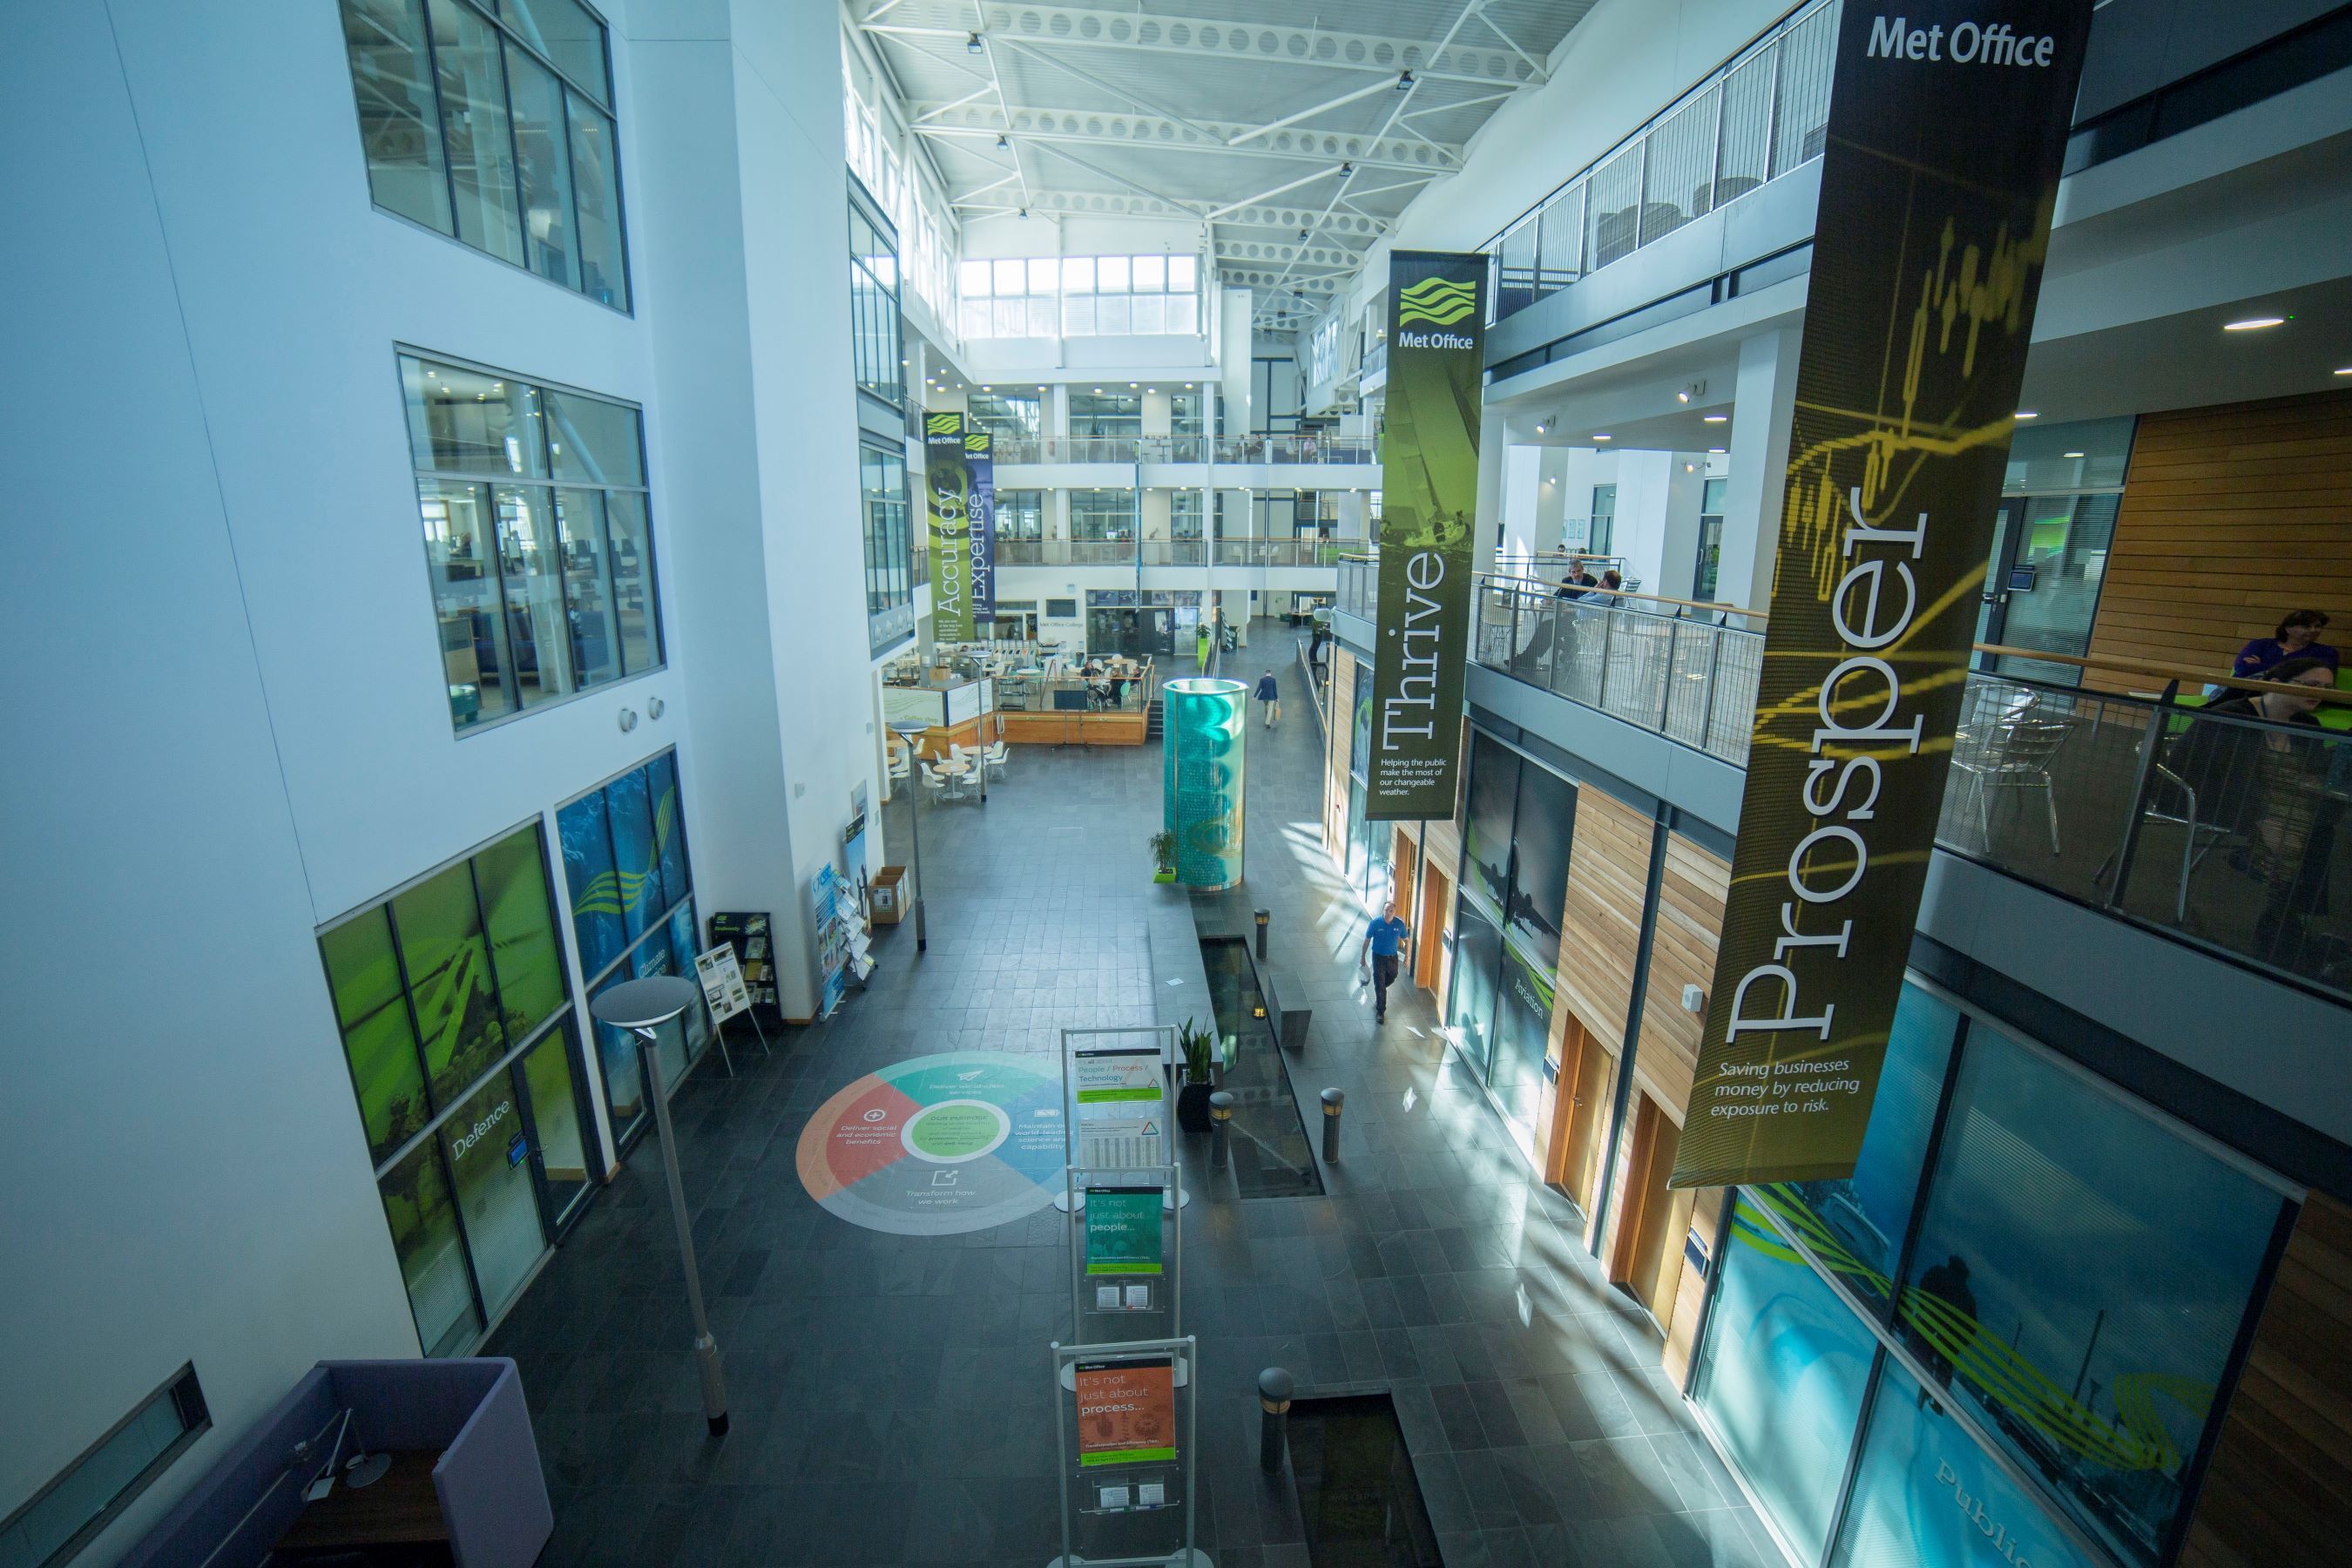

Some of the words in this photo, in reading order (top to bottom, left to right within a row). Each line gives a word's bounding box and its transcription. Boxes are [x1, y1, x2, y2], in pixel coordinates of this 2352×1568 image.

[1867, 16, 1943, 61] Met
[1950, 22, 2054, 67] Office
[1399, 332, 1429, 348] Met
[1430, 333, 1473, 349] Office
[937, 487, 963, 617] Accuracy
[969, 494, 990, 600] Expertise
[1382, 552, 1444, 750] Thrive
[1381, 759, 1409, 767] Helping
[1425, 759, 1447, 767] public
[1726, 487, 1928, 1044] Prosper
[1394, 778, 1435, 787] changeable
[639, 949, 666, 978] Climate
[1515, 977, 1543, 1019] Aviation
[1079, 1074, 1124, 1083] Technology
[1719, 1062, 1770, 1079] Saving
[1774, 1059, 1850, 1075] businesses
[1714, 1084, 1768, 1098] money
[1773, 1081, 1790, 1098] by
[1794, 1077, 1860, 1094] reducing
[1711, 1103, 1779, 1119] exposure
[1783, 1101, 1798, 1113] to
[1802, 1098, 1828, 1112] risk.
[452, 1100, 510, 1161] Defence
[1090, 1212, 1109, 1221] just
[1112, 1210, 1144, 1220] about
[1090, 1223, 1135, 1233] people...
[1079, 1376, 1099, 1387] It's
[1103, 1375, 1126, 1384] not
[1080, 1390, 1105, 1403] just
[1109, 1387, 1149, 1398] about
[1081, 1403, 1145, 1416] process...
